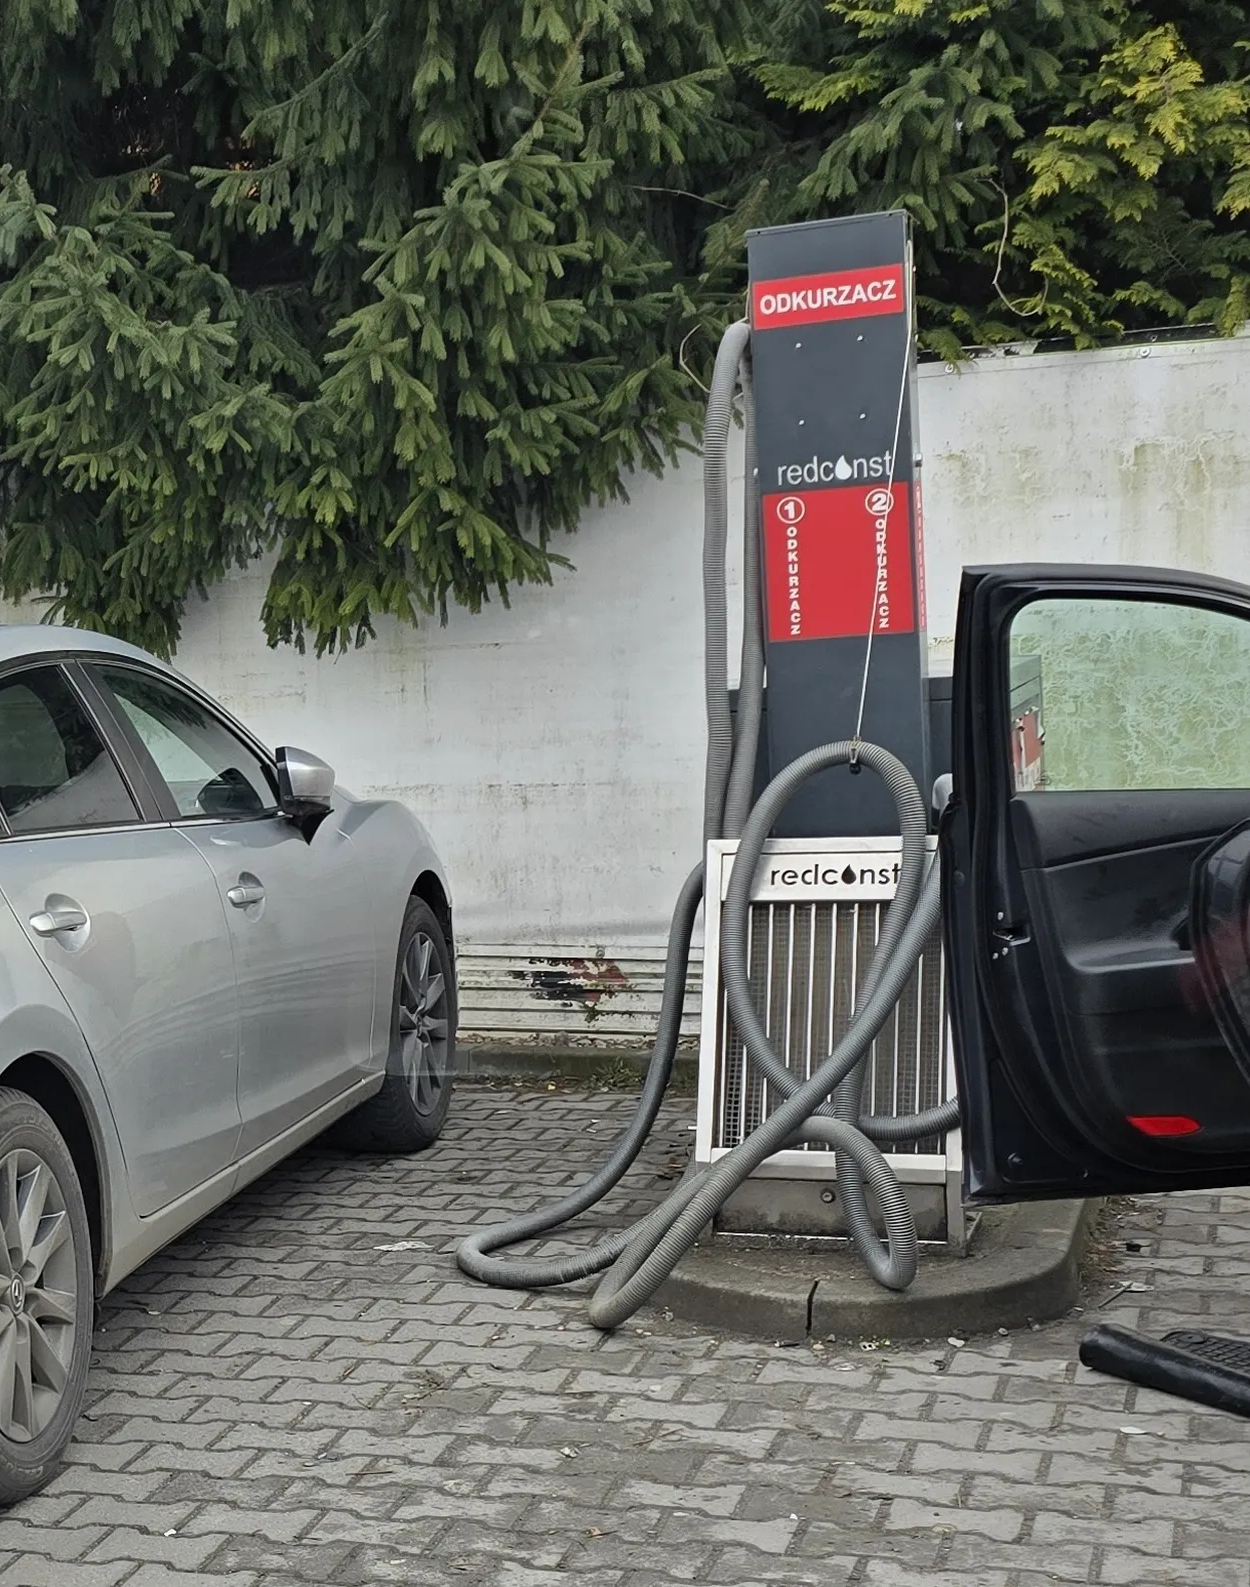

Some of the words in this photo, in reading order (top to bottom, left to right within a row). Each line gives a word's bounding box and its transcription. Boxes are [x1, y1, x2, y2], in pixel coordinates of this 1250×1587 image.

[759, 279, 897, 315] ODKURZACZ
[784, 501, 796, 519] 1
[871, 493, 888, 512] 2
[786, 526, 801, 635] ODKURZACZ
